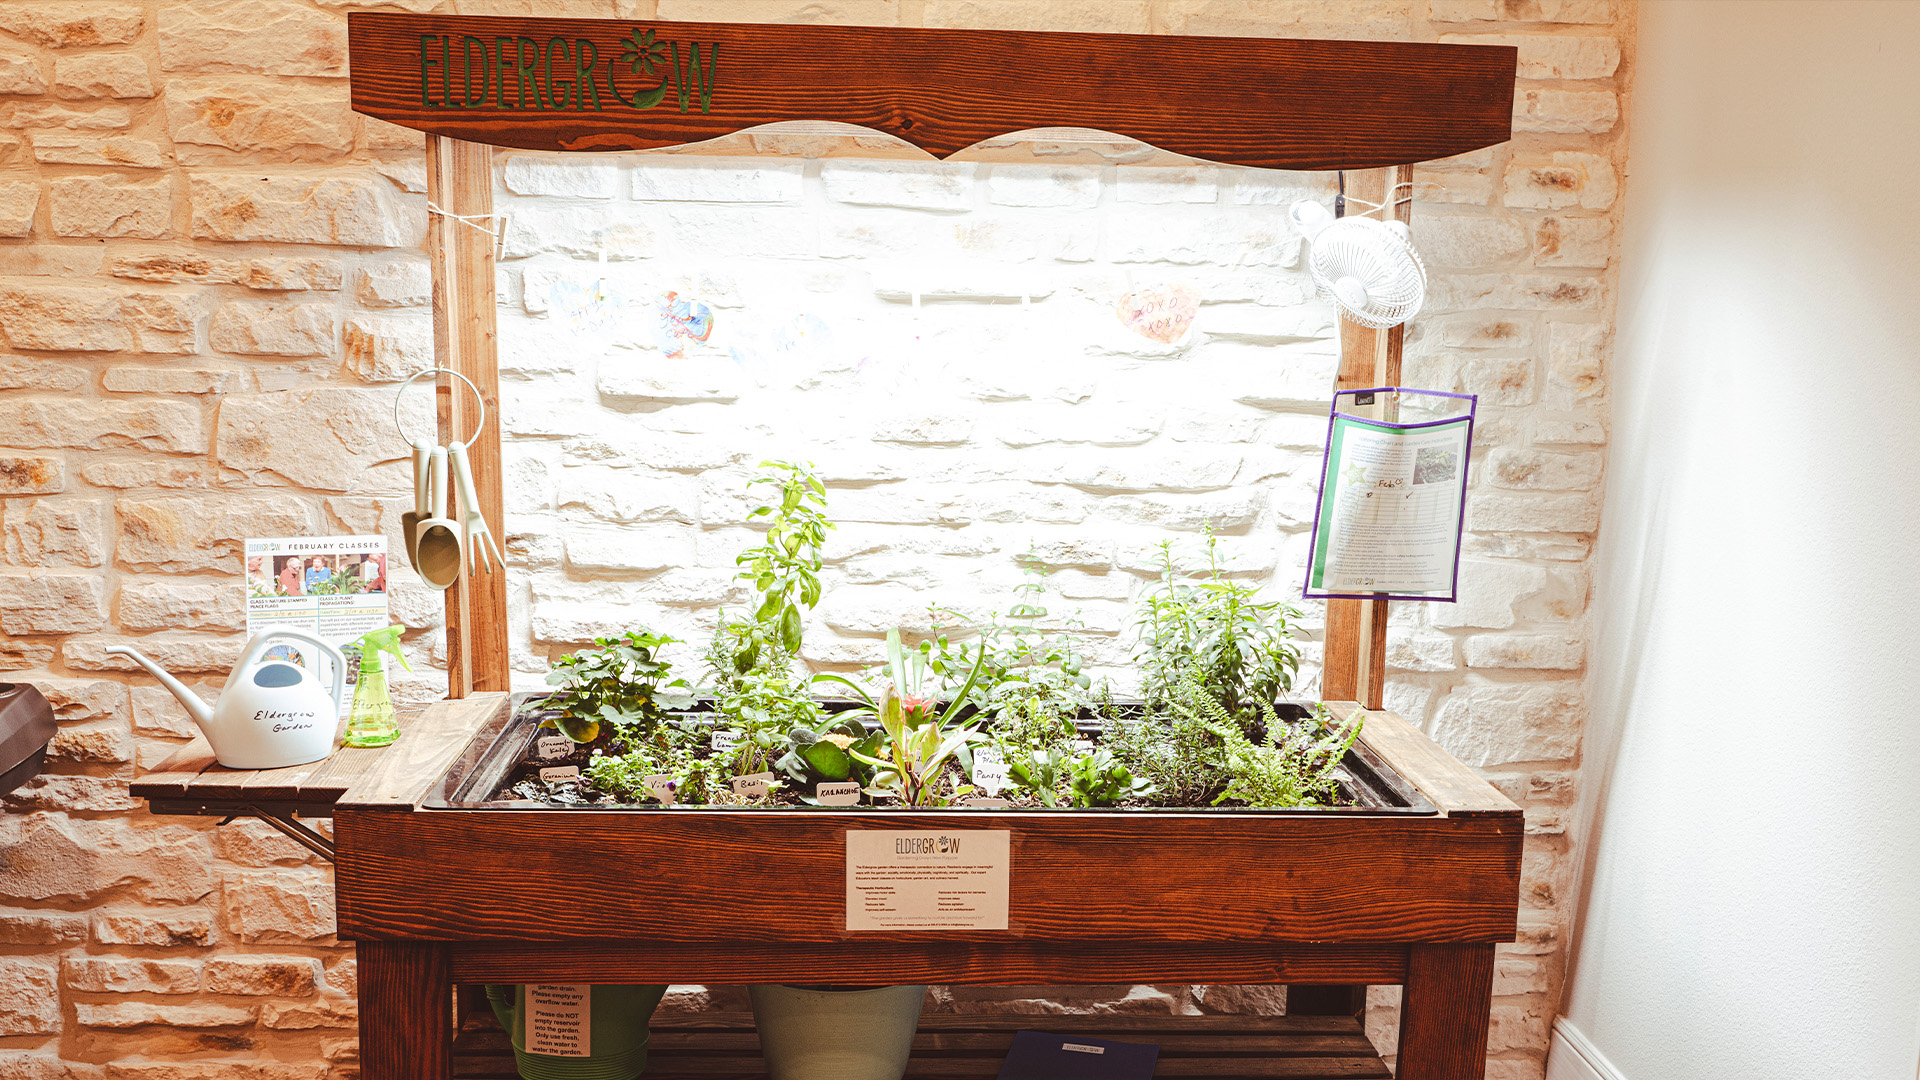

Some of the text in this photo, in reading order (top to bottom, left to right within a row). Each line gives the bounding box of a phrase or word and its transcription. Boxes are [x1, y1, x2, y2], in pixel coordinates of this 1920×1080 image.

[420, 27, 720, 114] ELDERGROW
[254, 710, 315, 722] Eldergrow
[272, 724, 312, 733] Garden
[977, 770, 1001, 784] Pansy
[896, 836, 960, 854] ELDERGROW
